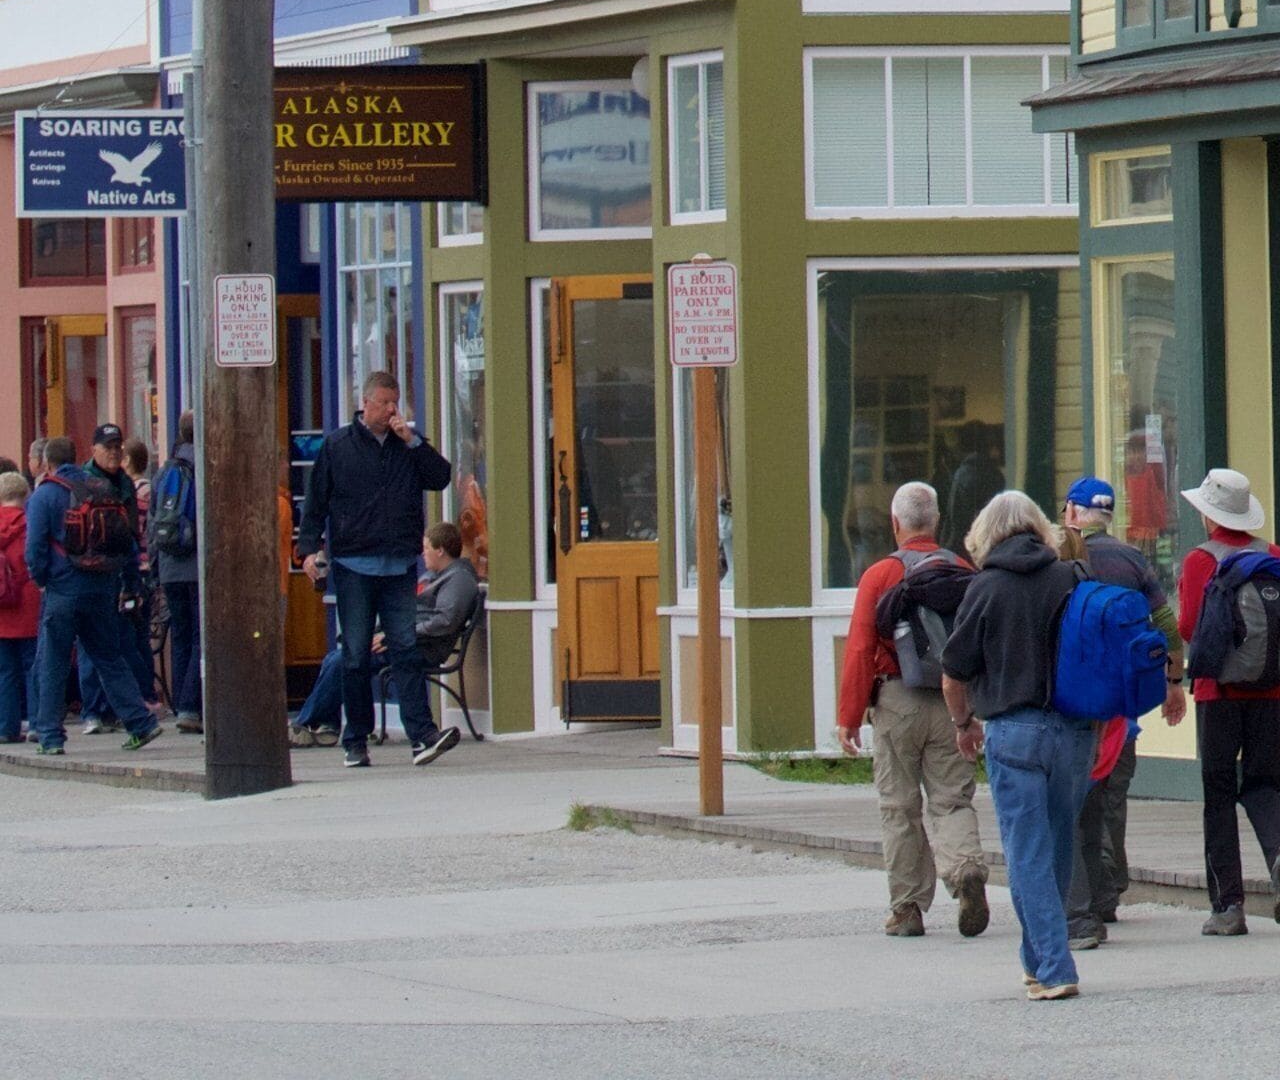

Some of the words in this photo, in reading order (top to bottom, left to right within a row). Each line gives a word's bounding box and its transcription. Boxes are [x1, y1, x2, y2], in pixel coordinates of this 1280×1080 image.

[282, 96, 404, 115] ALASKA
[39, 119, 142, 137] SOARING
[306, 122, 455, 148] GALLERY
[28, 149, 66, 158] Artifacts
[30, 163, 66, 173] Carvings
[284, 159, 335, 172] Furriers
[338, 159, 373, 171] Since
[376, 158, 404, 170] 1935
[32, 178, 61, 186] Knives
[313, 174, 351, 184] Owned
[353, 174, 362, 184] &
[365, 173, 415, 186] Operated
[87, 190, 138, 205] Native
[142, 190, 176, 205] Arts
[691, 274, 726, 285] HOUR
[235, 284, 264, 293] HOUR
[674, 286, 732, 297] PARKING
[222, 293, 268, 303] PARKING
[686, 297, 720, 308] ONLY
[230, 303, 258, 312] ONLY
[675, 325, 687, 334] NO
[691, 324, 735, 333] VEHICLES
[686, 336, 709, 345] OVER
[680, 347, 690, 356] IN
[695, 346, 730, 356] LENGTH
